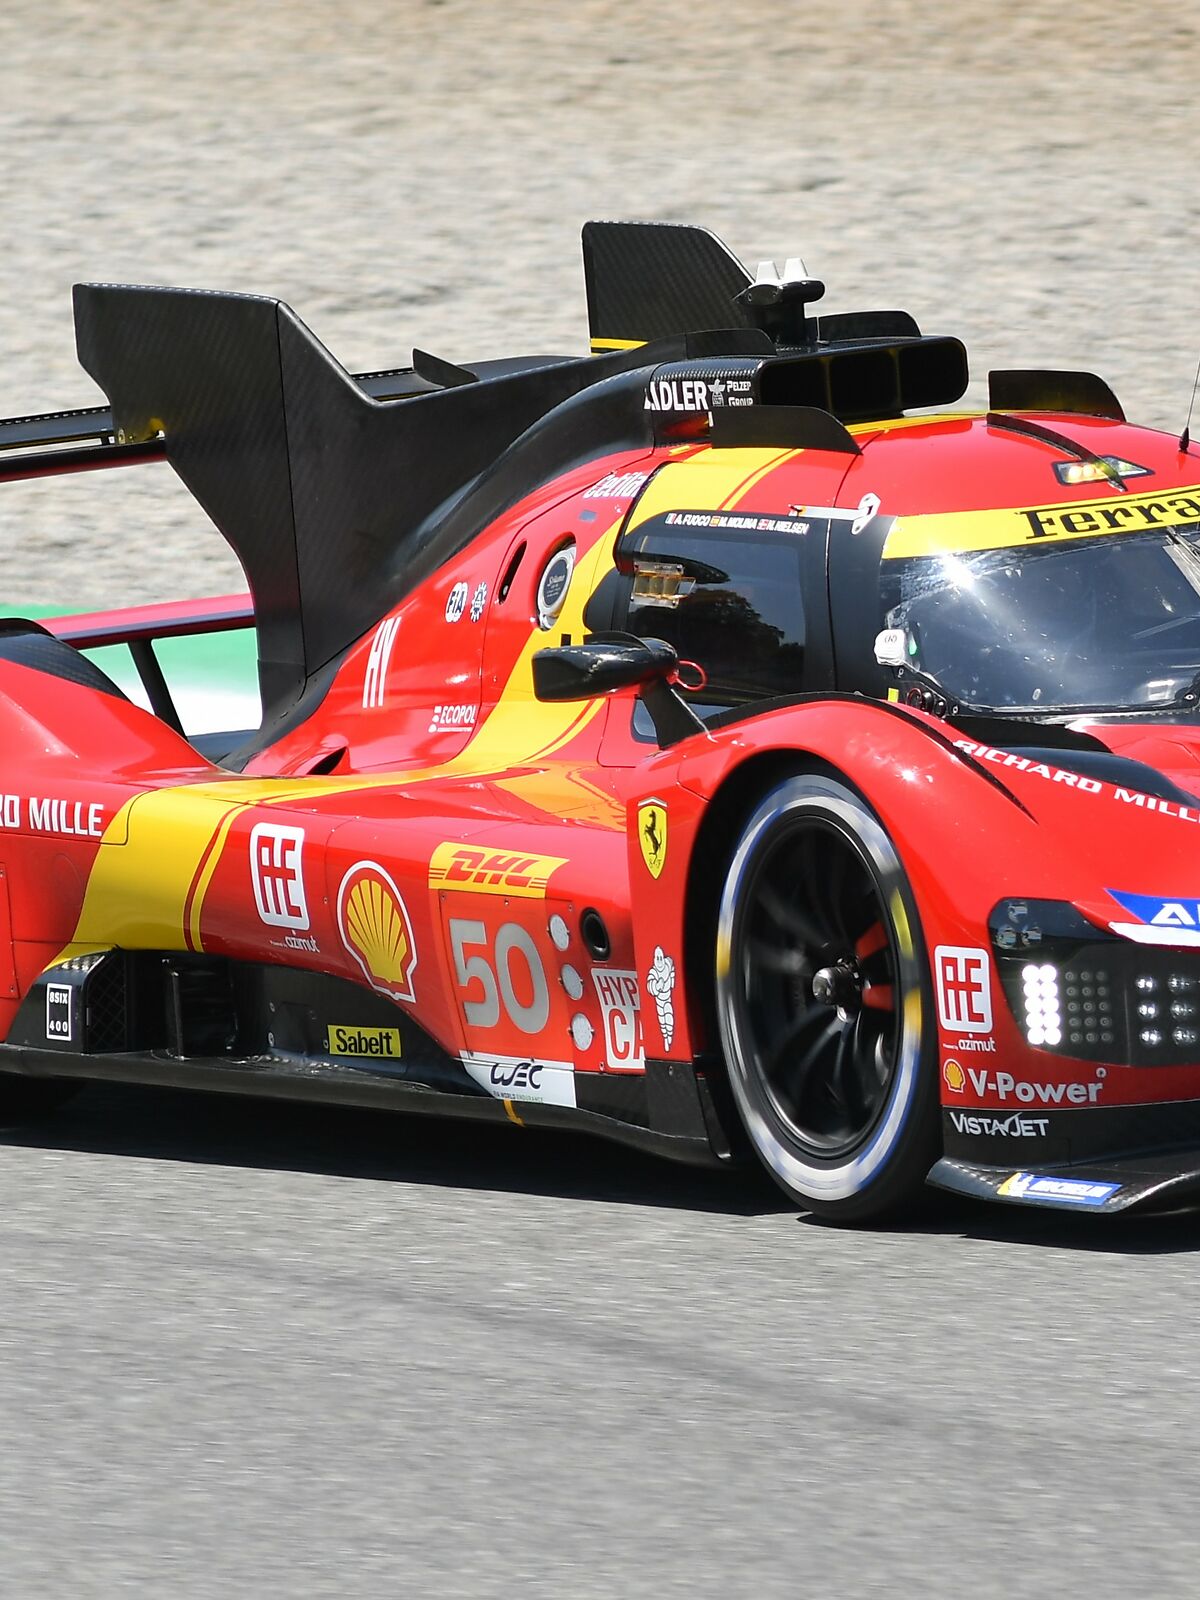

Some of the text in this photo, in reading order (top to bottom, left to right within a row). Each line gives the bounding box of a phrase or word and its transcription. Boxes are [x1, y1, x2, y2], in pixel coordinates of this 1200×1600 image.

[644, 381, 709, 411] ADLER
[439, 705, 477, 724] ECOPOL
[952, 739, 1103, 794] RICHARD
[29, 797, 104, 837] MILLE
[444, 850, 540, 888] DHL
[285, 929, 320, 953] azimut
[449, 918, 550, 1035] 50
[49, 1020, 68, 1032] 400
[335, 1028, 393, 1055] Sabelt
[958, 1033, 996, 1052] azimut
[490, 1062, 544, 1090] WEC
[968, 1068, 1103, 1103] V-Power
